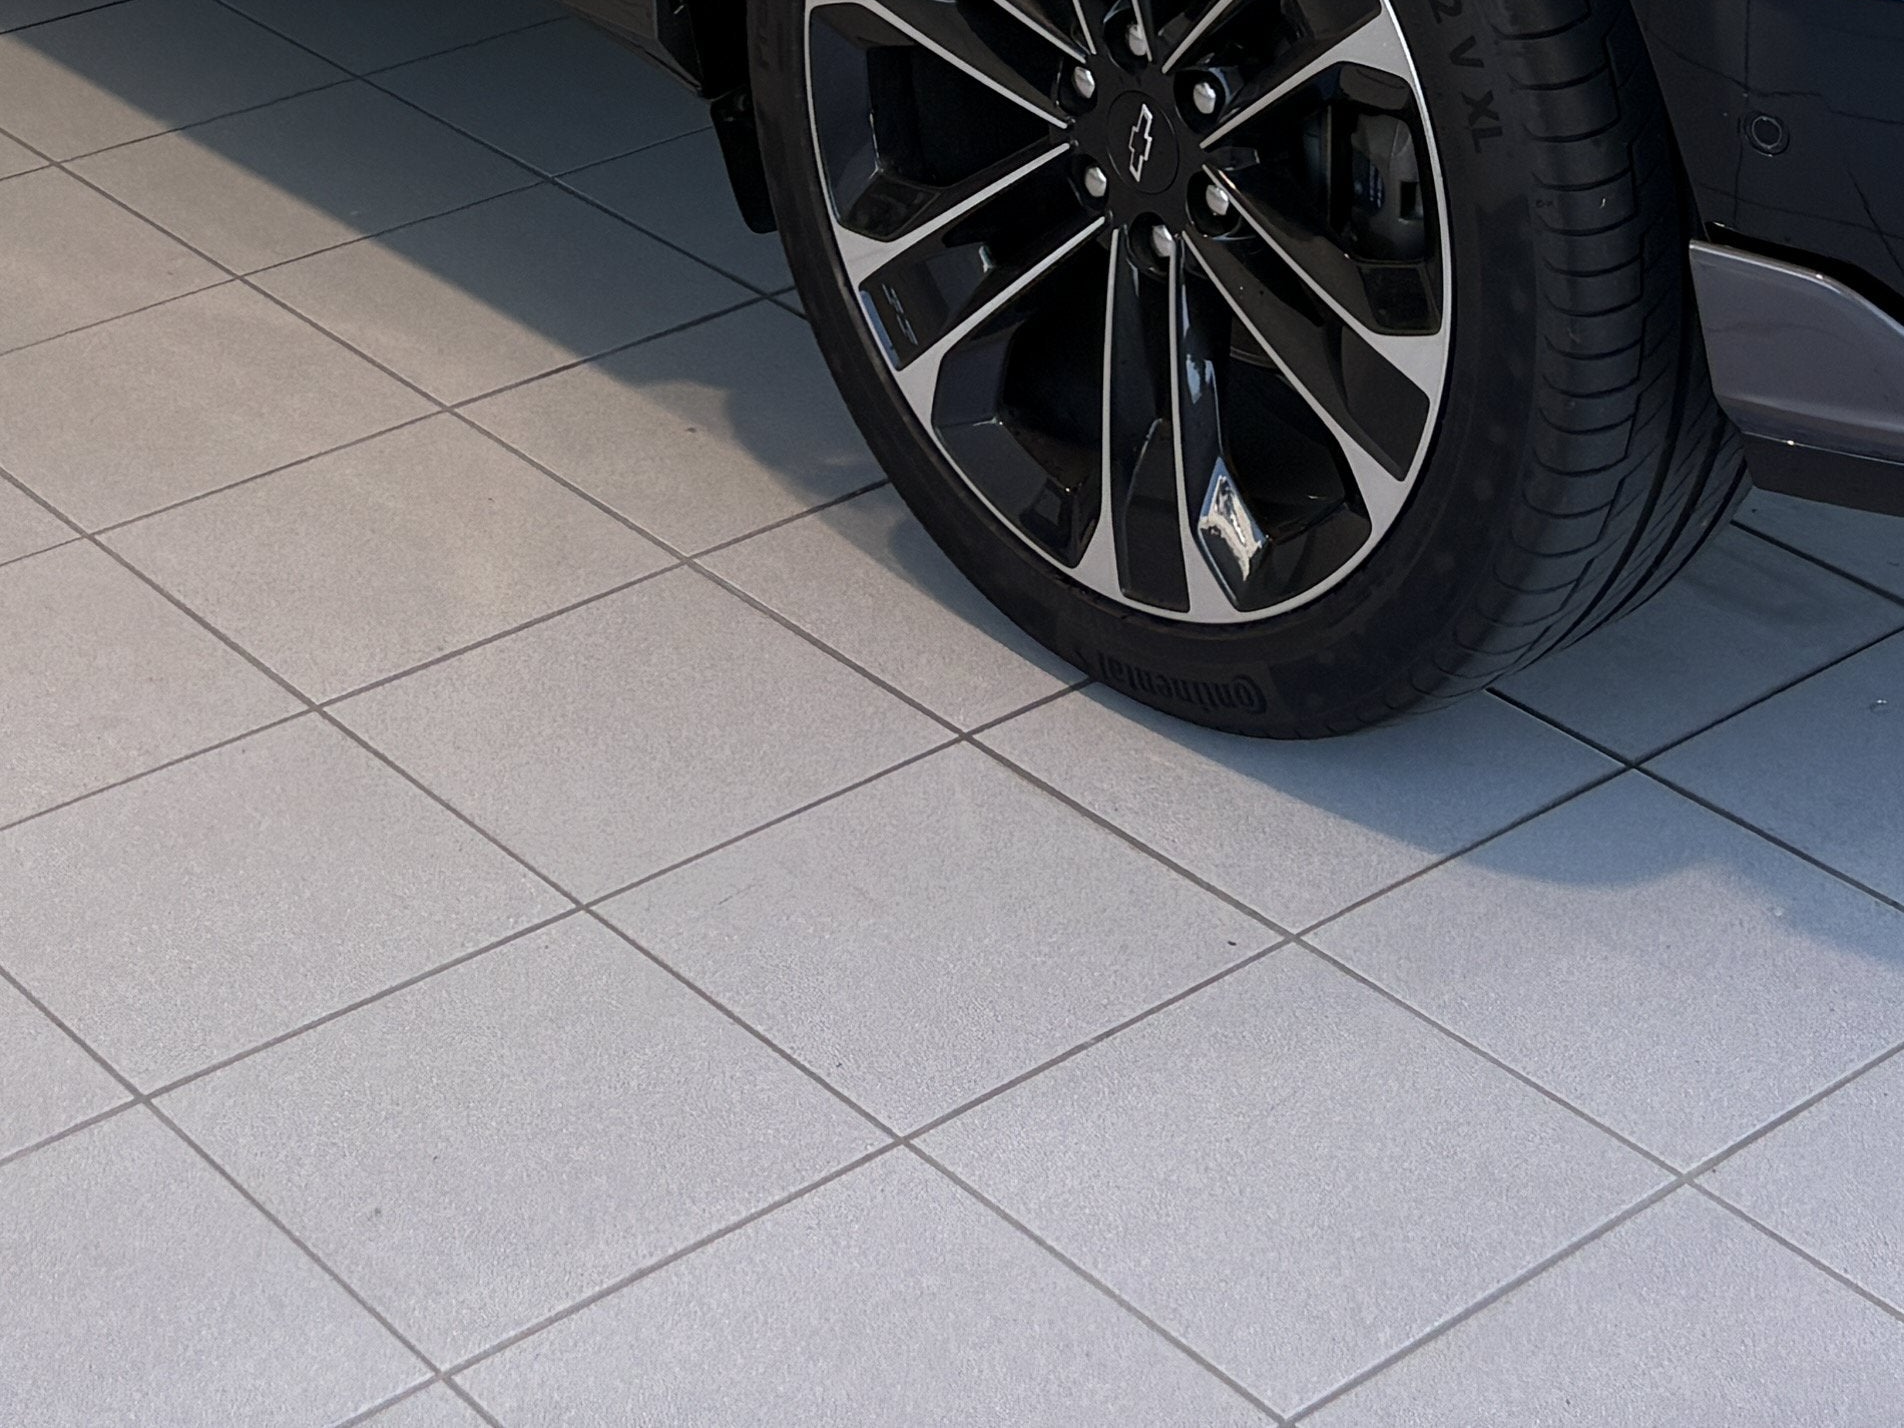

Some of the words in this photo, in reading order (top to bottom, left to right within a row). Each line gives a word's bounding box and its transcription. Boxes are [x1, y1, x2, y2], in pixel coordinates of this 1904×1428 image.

[1449, 34, 1485, 69] V
[1461, 89, 1504, 154] XL
[1097, 649, 1268, 715] Continental
